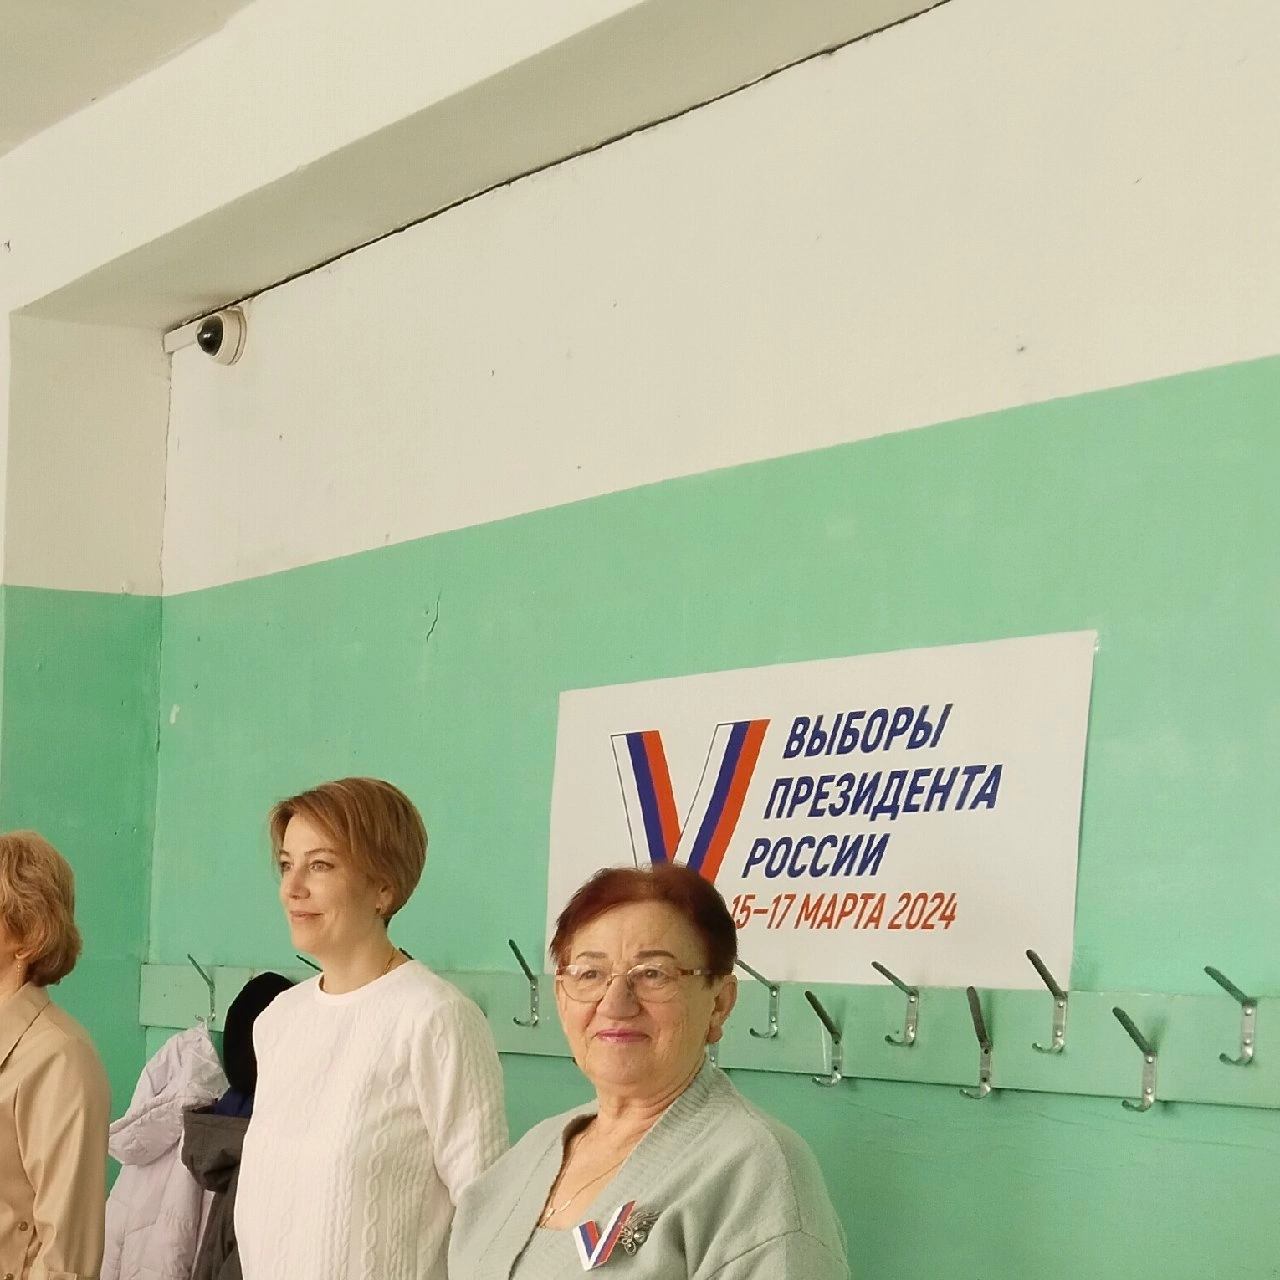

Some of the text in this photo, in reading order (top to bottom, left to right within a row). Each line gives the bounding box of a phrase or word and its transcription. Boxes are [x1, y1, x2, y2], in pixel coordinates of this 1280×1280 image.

[782, 703, 953, 759] ВЫБОРЫ
[764, 764, 1003, 821] ПРЕЗИДЕНТА
[741, 833, 891, 879] РОССИИ
[794, 892, 887, 930] МАРТА
[888, 892, 957, 930] 2024
